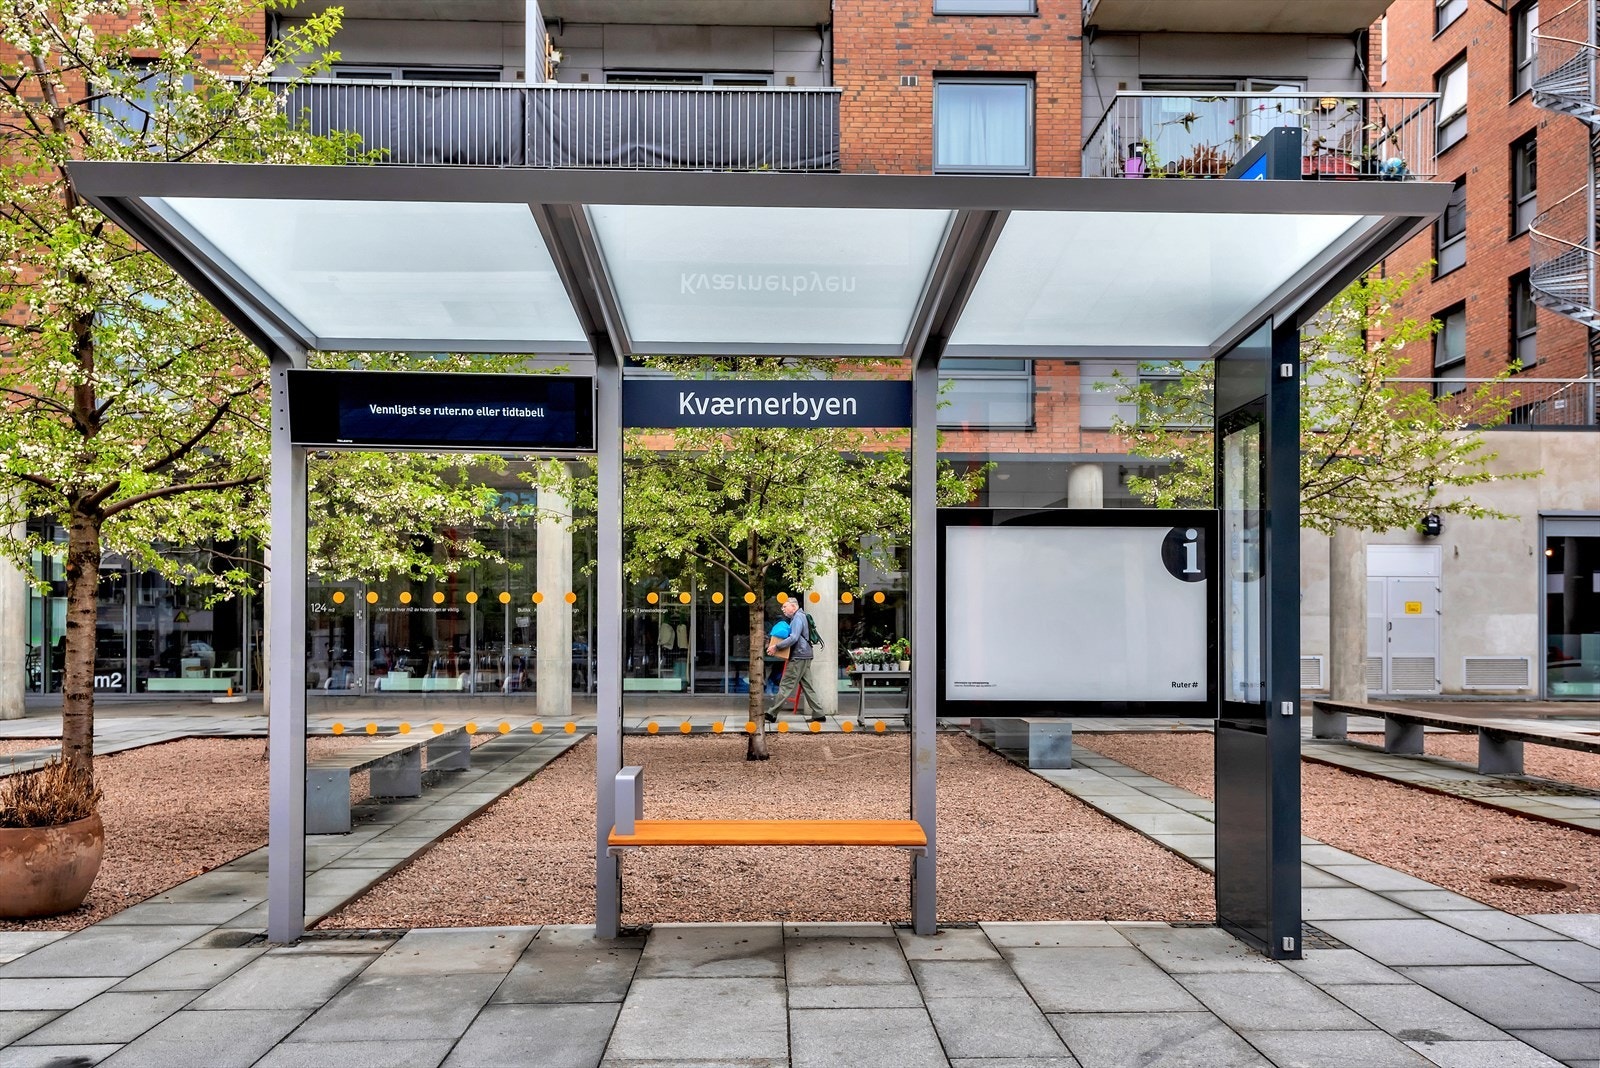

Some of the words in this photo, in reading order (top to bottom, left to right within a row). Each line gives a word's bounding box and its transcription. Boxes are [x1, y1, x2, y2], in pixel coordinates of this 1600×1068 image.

[369, 404, 417, 417] Vennligst
[419, 406, 431, 415] se
[433, 407, 474, 416] ruter.no
[476, 407, 500, 417] eller
[502, 407, 545, 418] tidtabell
[679, 392, 857, 421] Kværnerbyen
[311, 603, 327, 613] 124
[94, 672, 122, 688] m2
